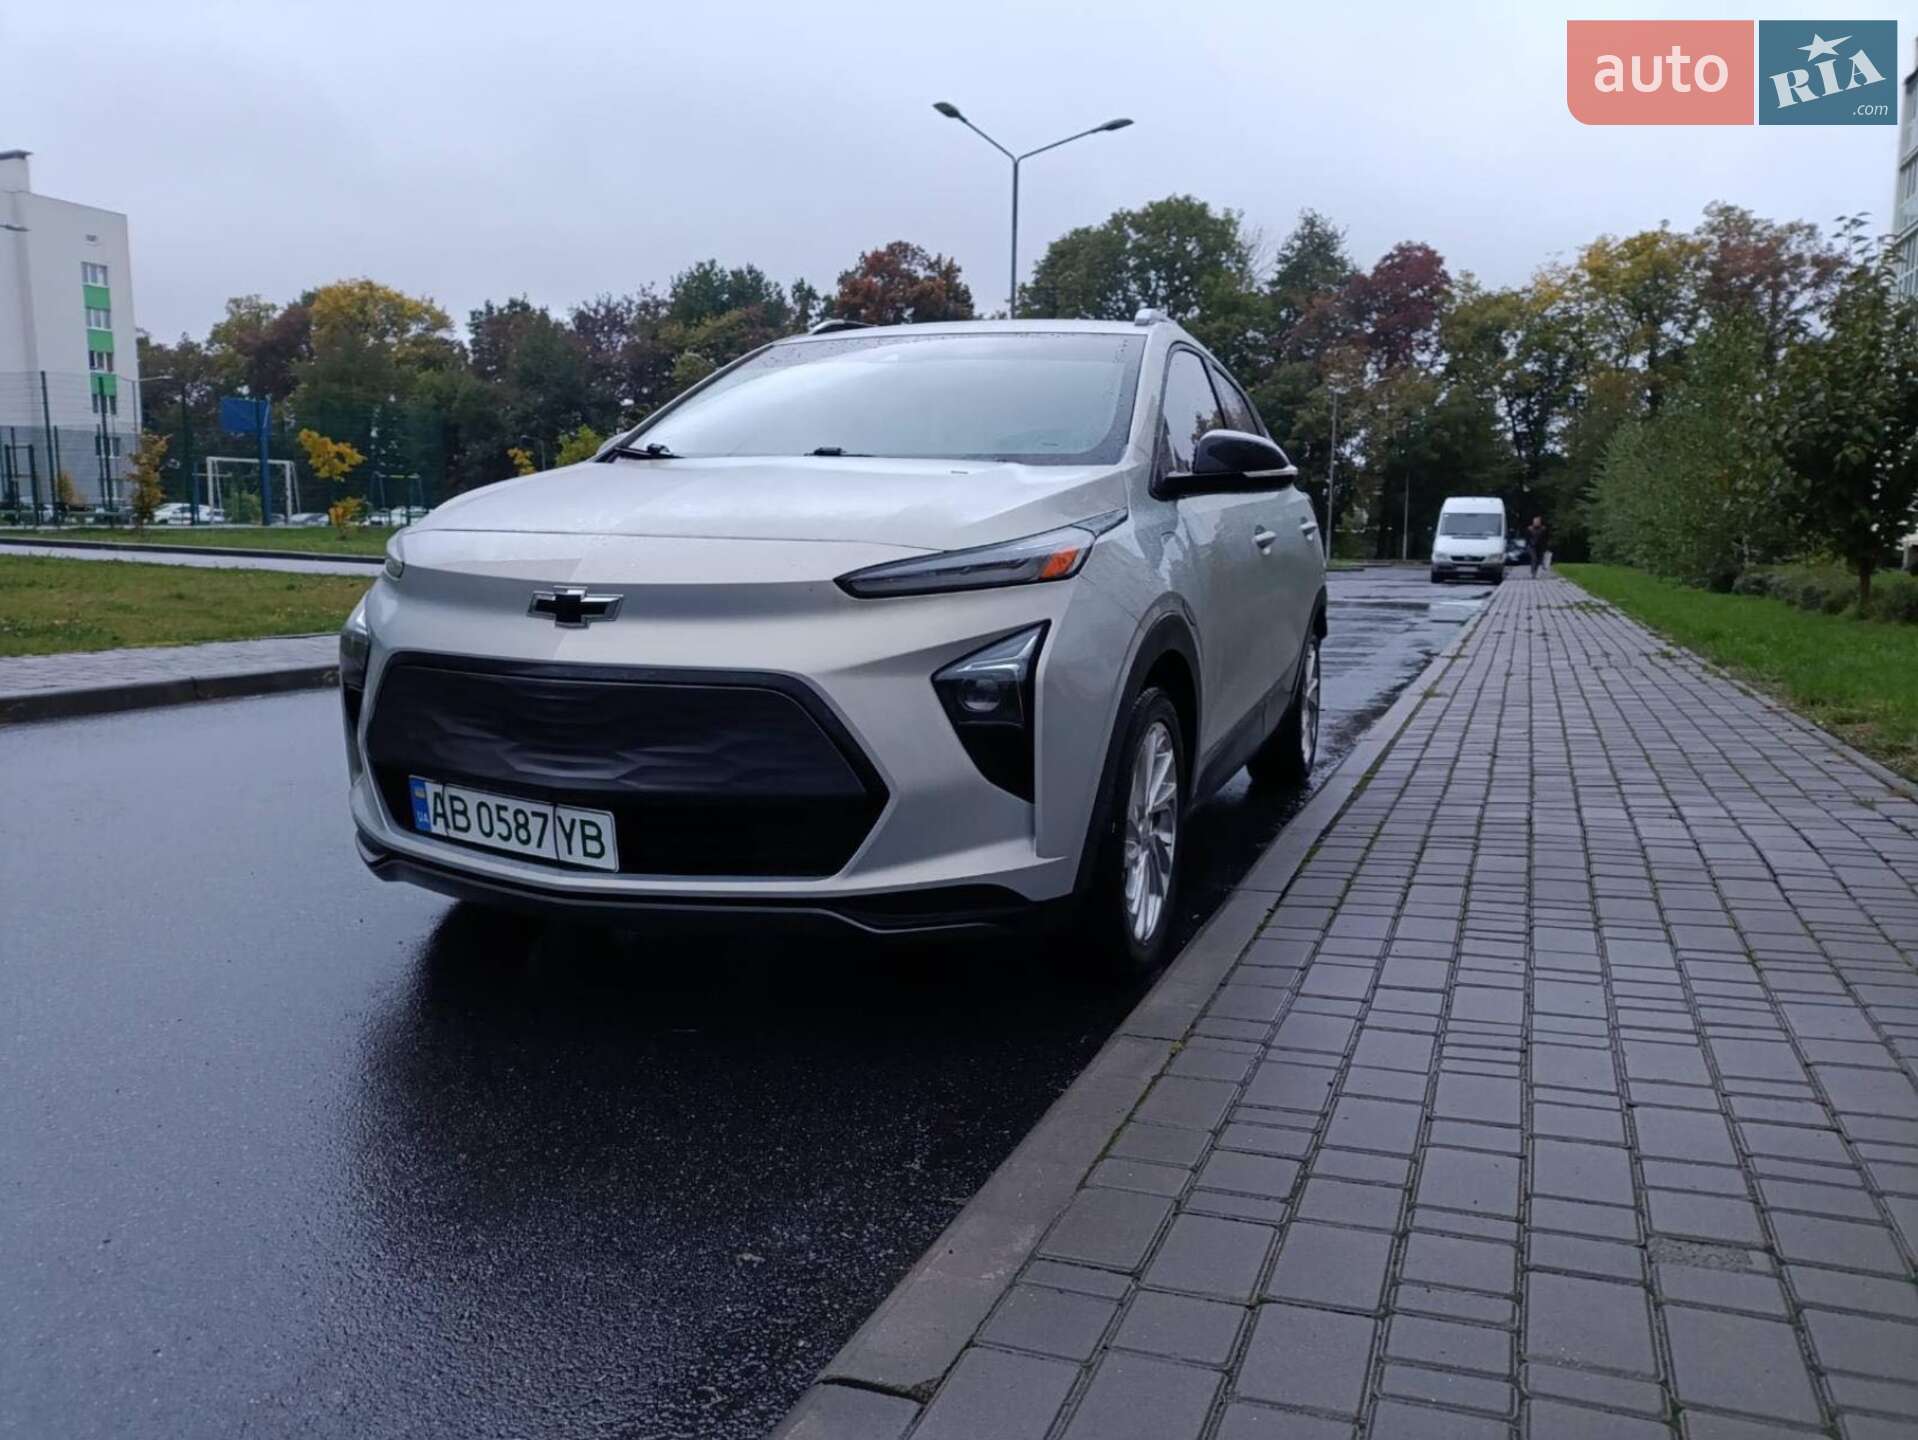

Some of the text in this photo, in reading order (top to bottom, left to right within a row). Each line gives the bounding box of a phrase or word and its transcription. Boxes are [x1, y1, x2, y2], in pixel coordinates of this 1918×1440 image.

[432, 791, 606, 860] AB 0587 YB
